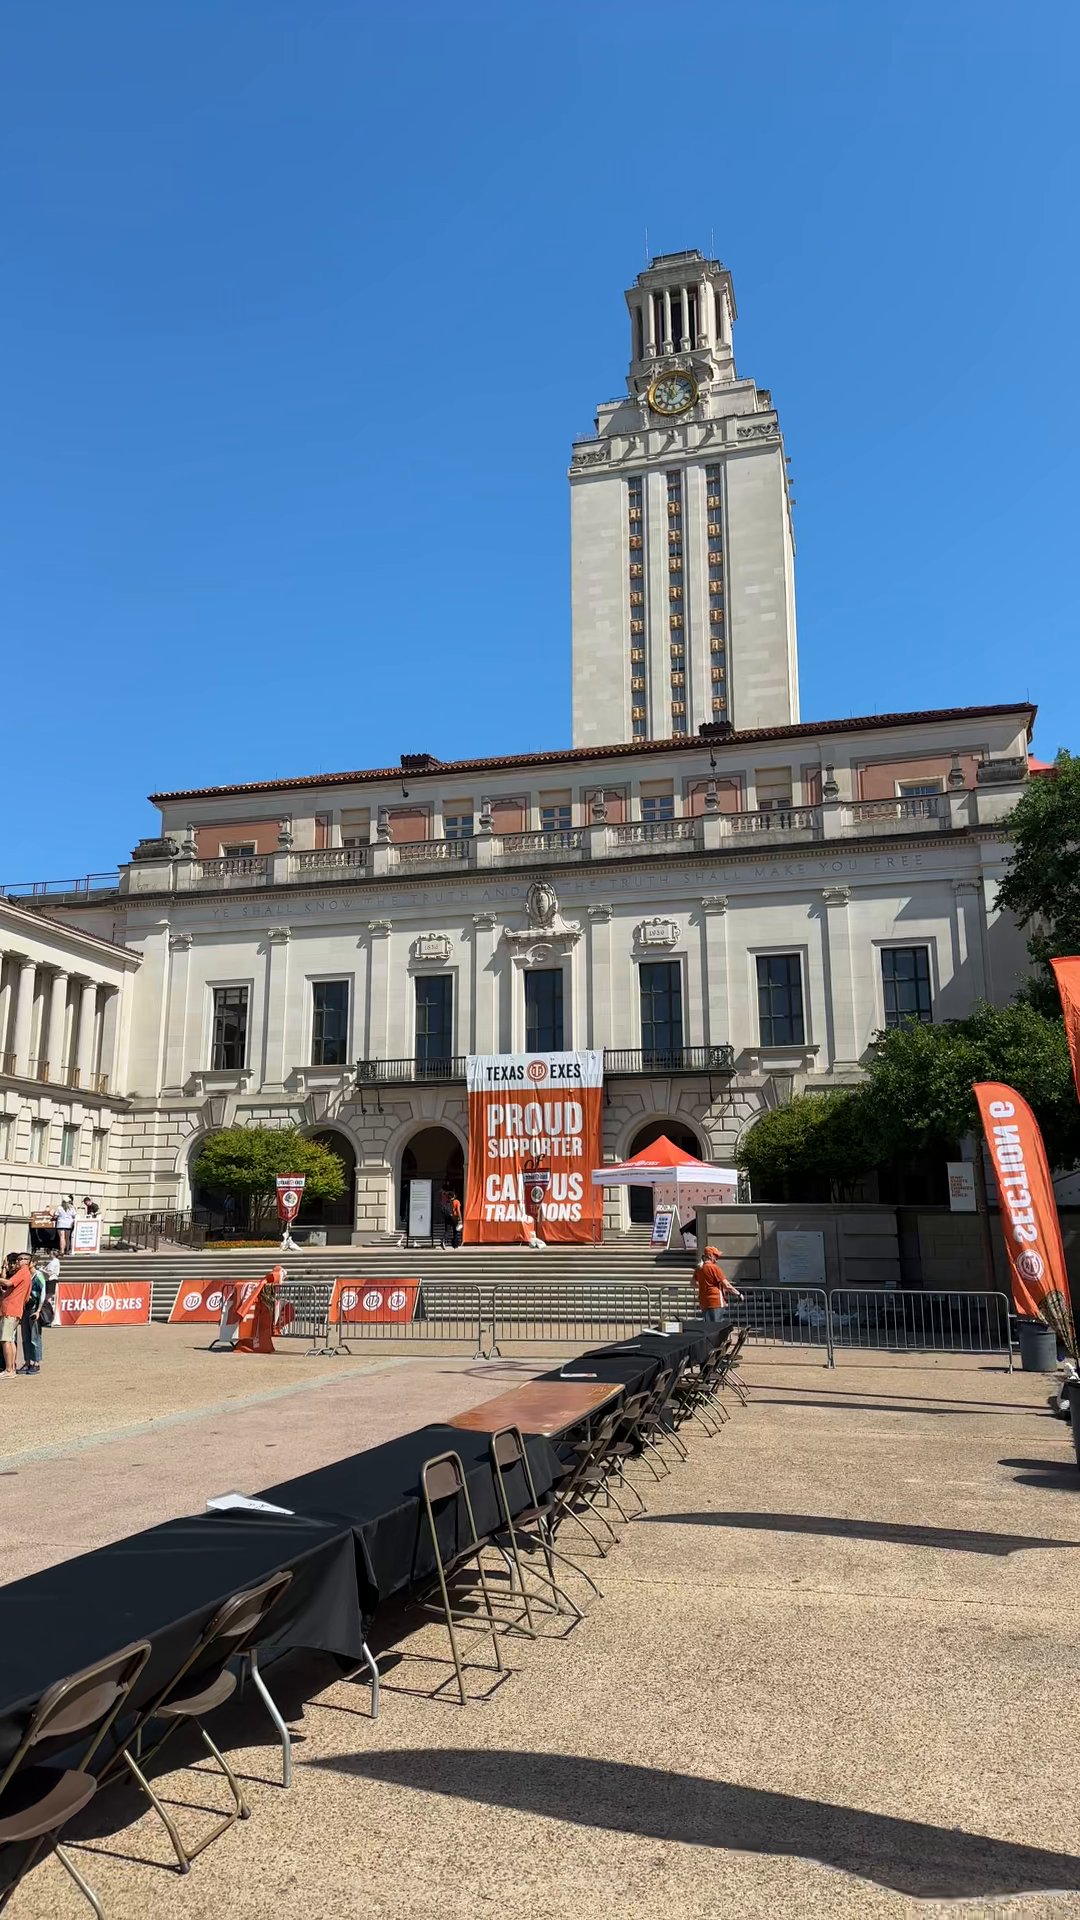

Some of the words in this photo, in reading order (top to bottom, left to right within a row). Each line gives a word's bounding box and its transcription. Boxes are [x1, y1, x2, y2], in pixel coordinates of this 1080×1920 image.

[213, 908, 229, 918] YE
[242, 904, 293, 917] SHALL
[304, 899, 353, 913] KNOW
[365, 896, 398, 907] THE
[411, 890, 469, 904] TRUTH
[483, 886, 520, 900] AND
[562, 880, 597, 892] THE
[610, 875, 669, 889] TRUTH
[684, 871, 741, 885] SHALL
[754, 863, 805, 878] MAKE
[819, 859, 858, 872] YOU
[874, 854, 923, 868] FREE
[486, 1065, 525, 1082] TEXAS
[550, 1063, 582, 1079] EXES
[487, 1101, 583, 1137] PROUD
[487, 1136, 583, 1159] SUPPORTER
[485, 1172, 584, 1203] CAUS
[61, 1299, 94, 1311] TEXAS
[115, 1297, 142, 1310] EXES
